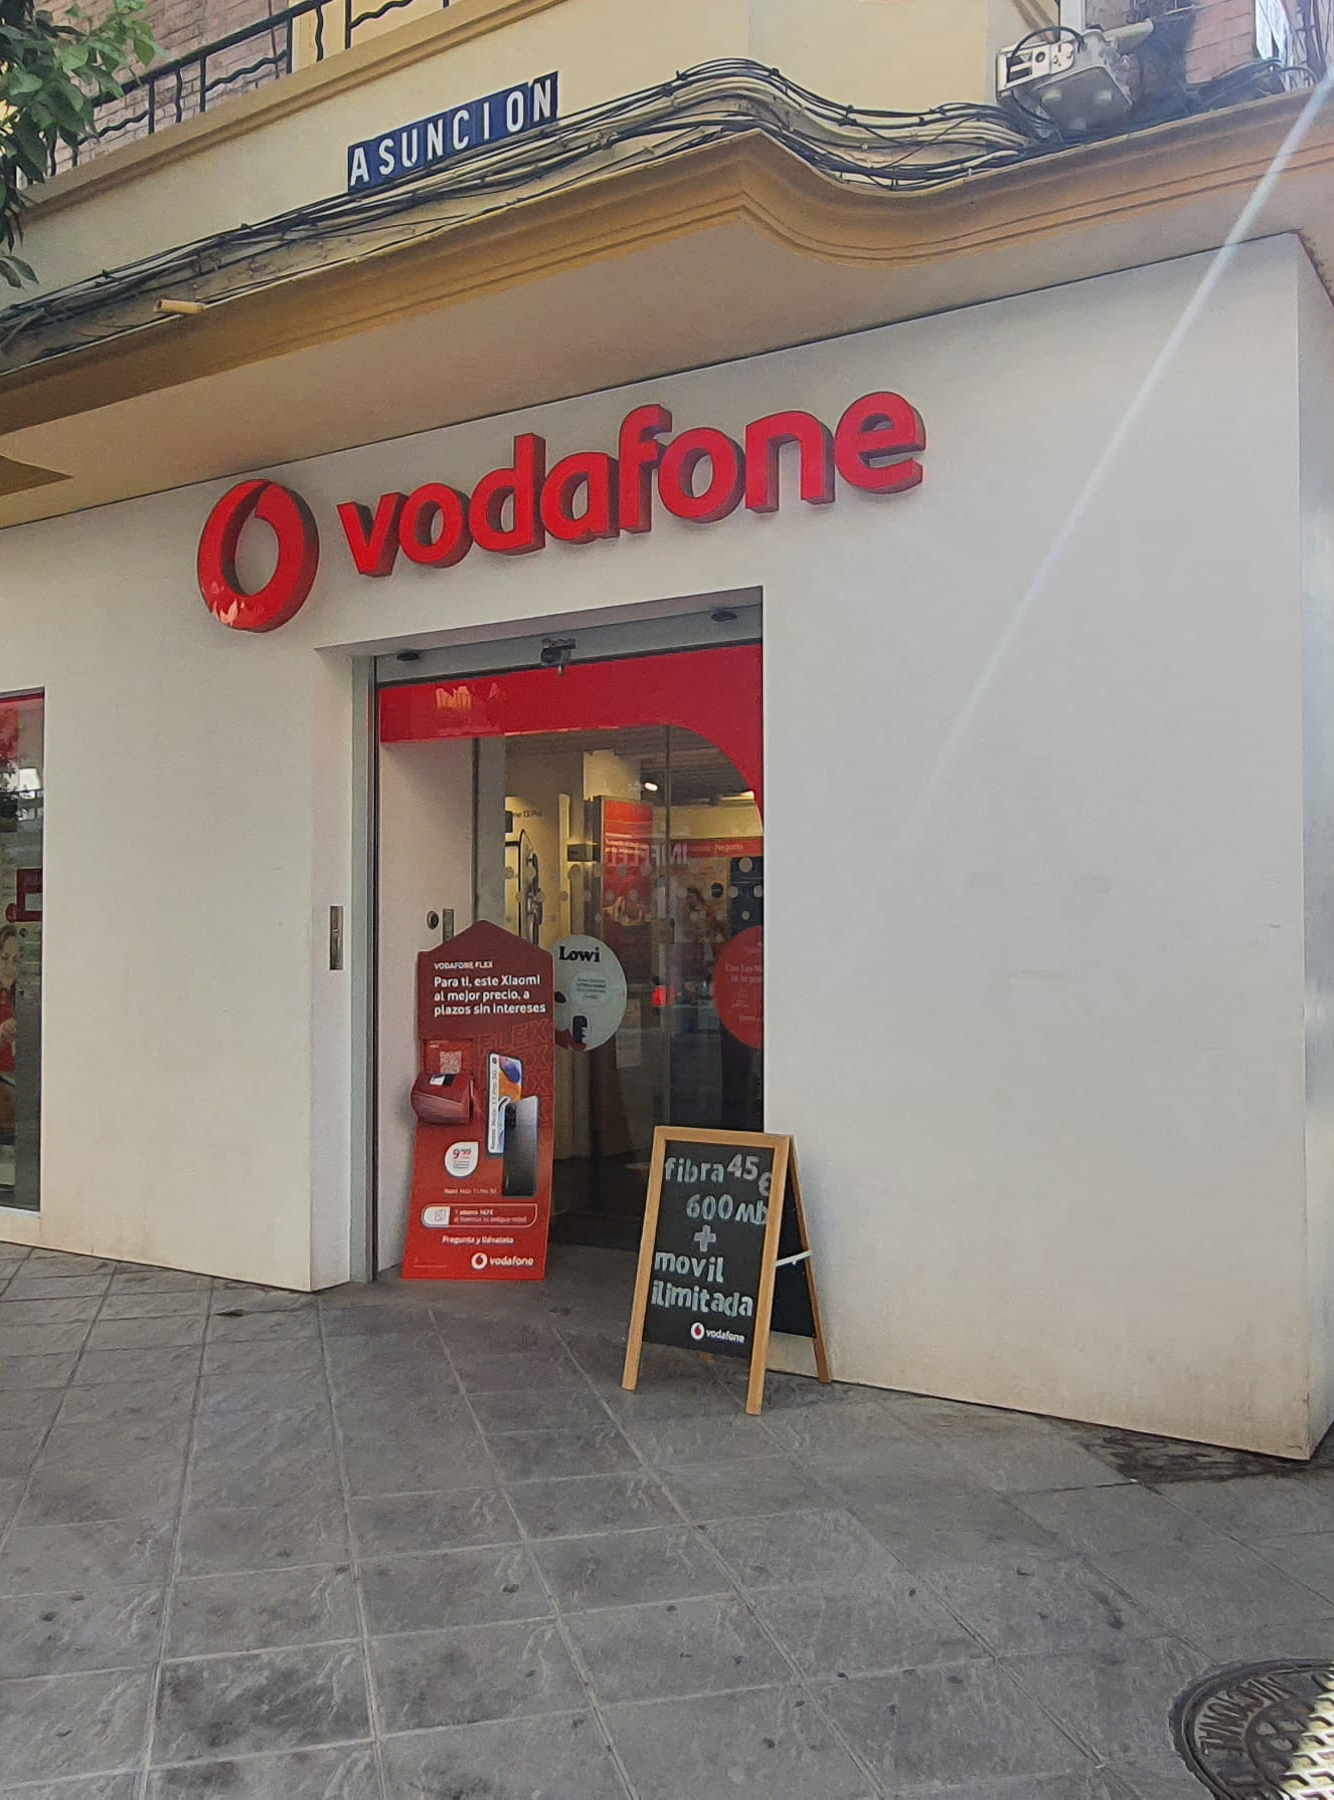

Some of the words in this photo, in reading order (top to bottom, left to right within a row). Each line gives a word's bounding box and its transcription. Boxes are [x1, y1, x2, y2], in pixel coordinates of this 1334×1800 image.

[349, 79, 552, 186] ASUNCION
[337, 390, 927, 578] vodafone
[559, 946, 600, 963] Lowi
[434, 961, 474, 970] VODAFONE
[475, 960, 493, 969] FLEX
[434, 976, 459, 988] Para
[474, 976, 499, 987] este
[500, 974, 540, 986] Xiaomi
[434, 991, 445, 1002] al
[447, 989, 480, 1003] mejor
[482, 989, 521, 1002] precio,
[523, 991, 530, 1000] a
[434, 1005, 471, 1018] plazos
[473, 1003, 491, 1015] sin
[492, 1003, 547, 1014] intereses
[665, 1157, 725, 1184] fibra
[442, 1235, 475, 1245] Pregunta
[489, 1255, 534, 1266] vodafone
[654, 1251, 725, 1284] movil
[650, 1280, 754, 1318] ilimitada
[706, 1329, 745, 1344] vodafone
